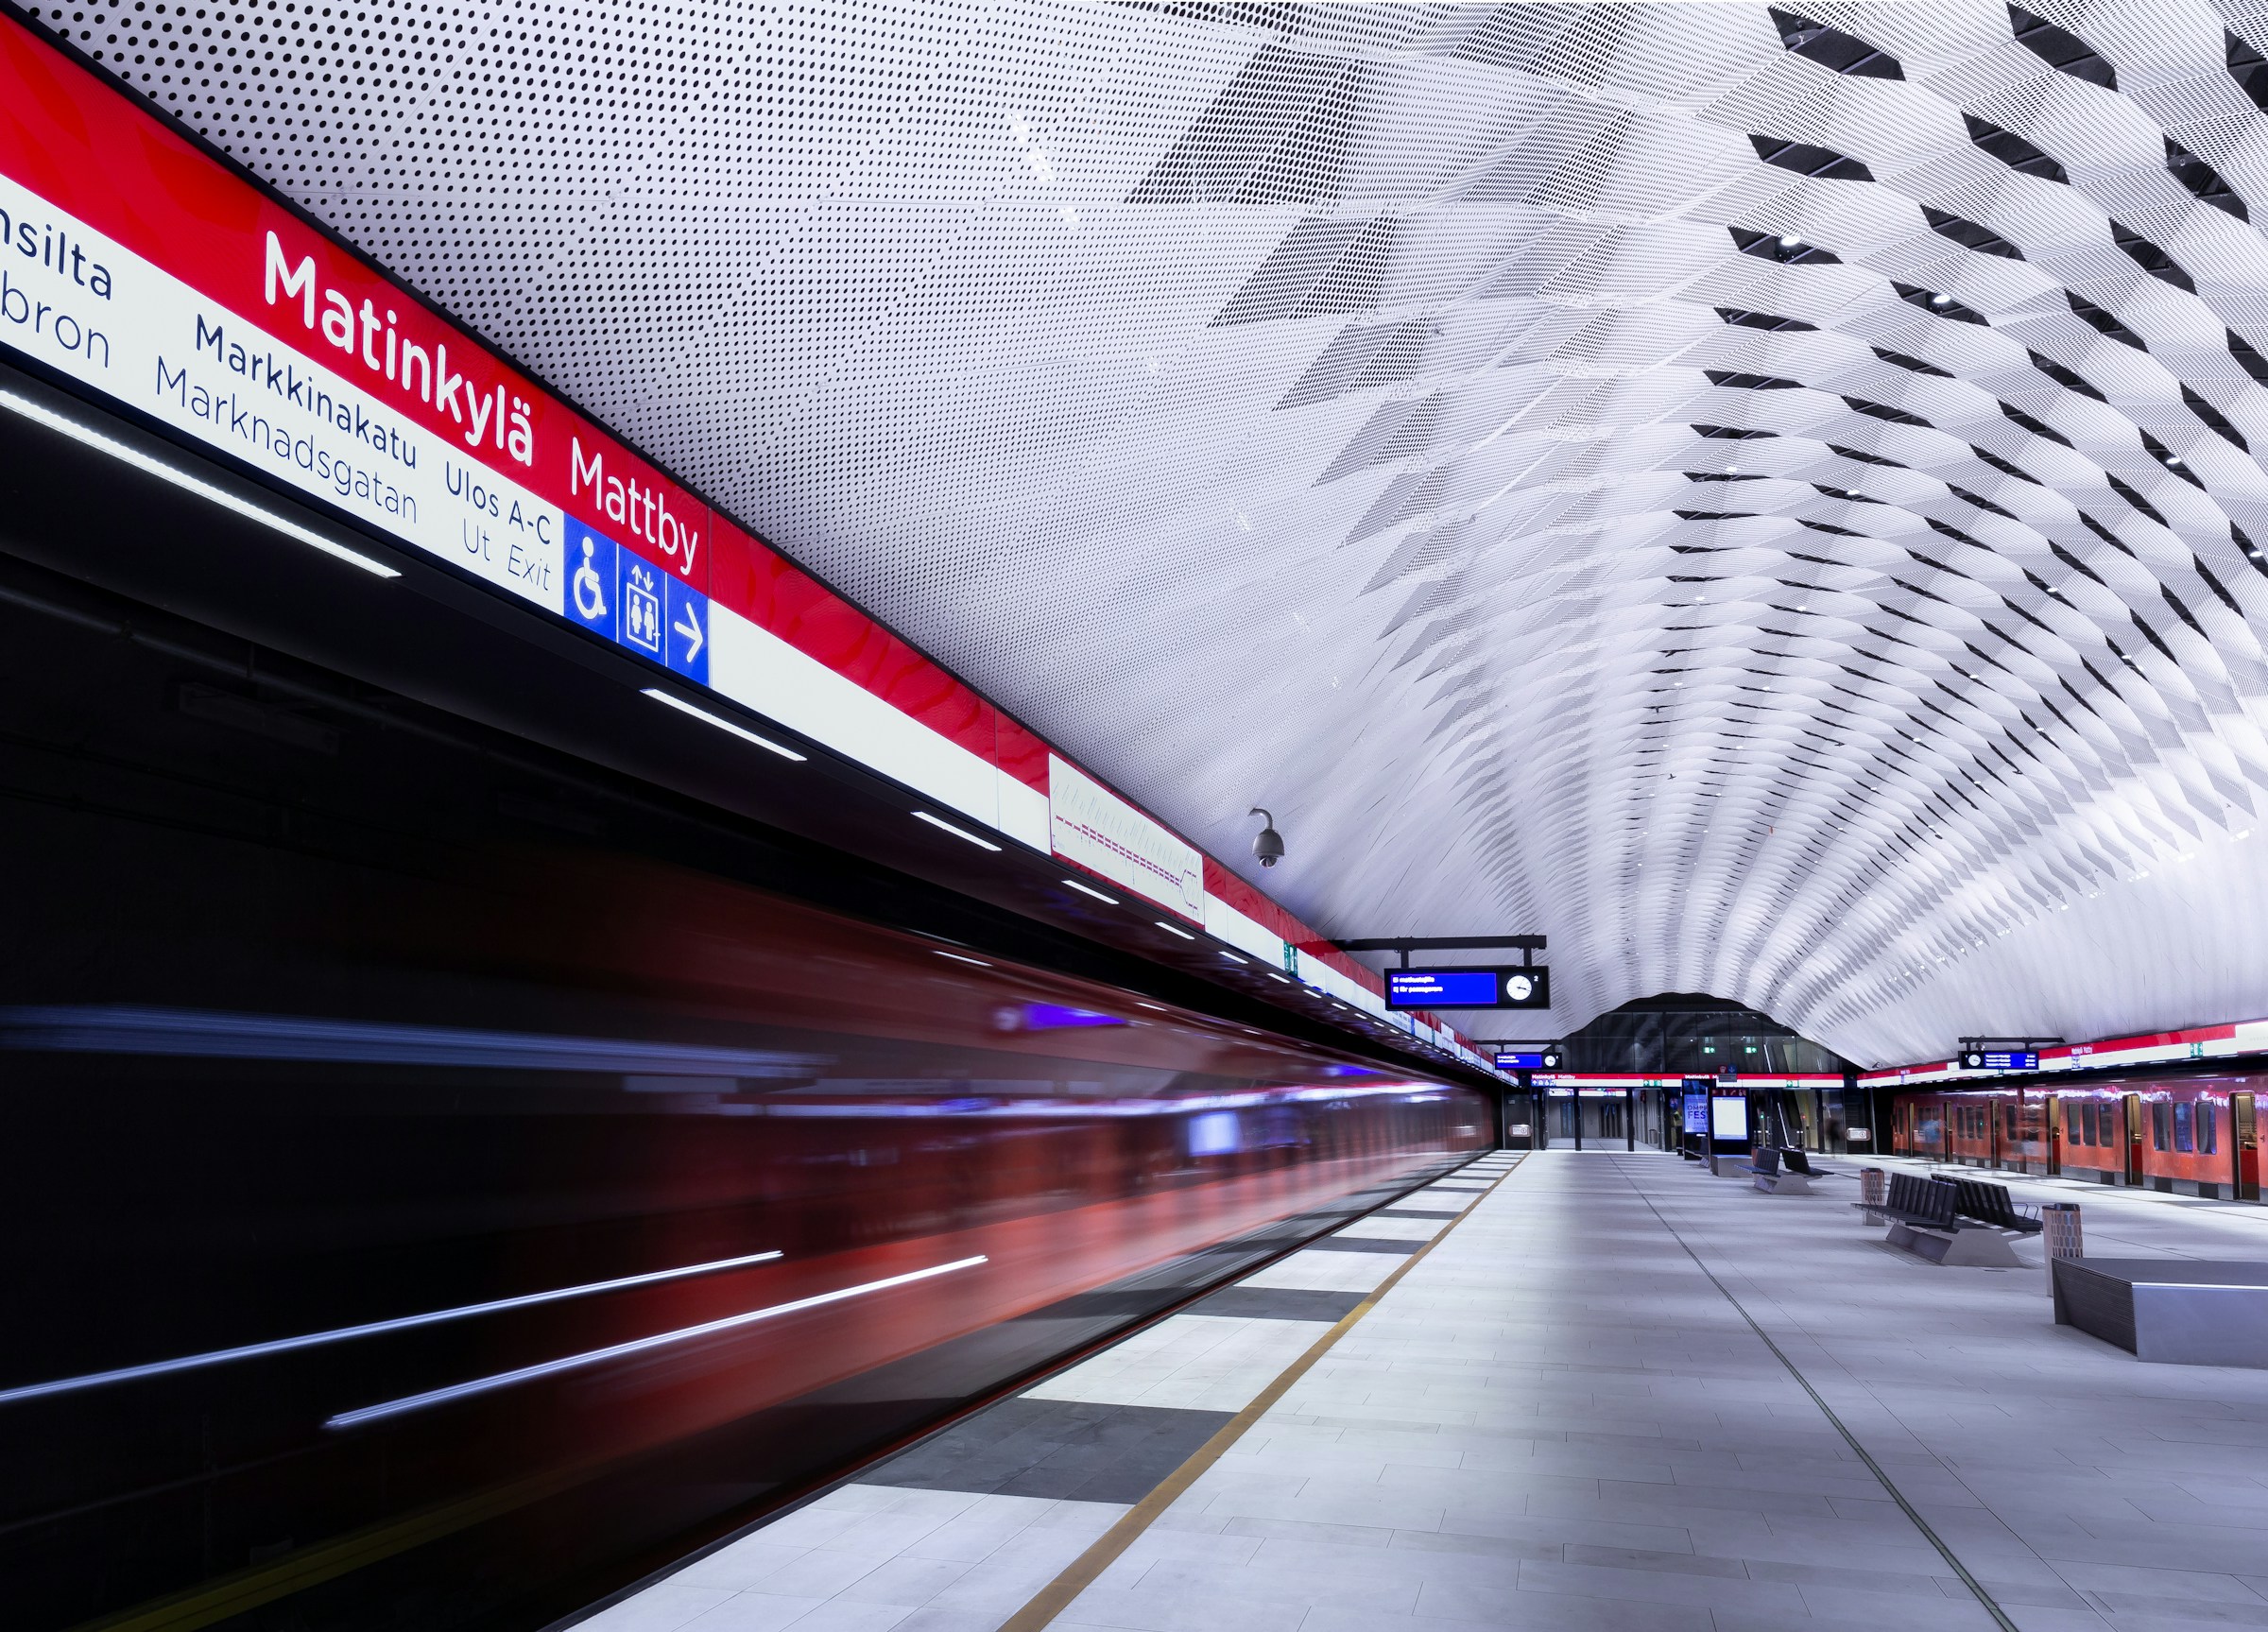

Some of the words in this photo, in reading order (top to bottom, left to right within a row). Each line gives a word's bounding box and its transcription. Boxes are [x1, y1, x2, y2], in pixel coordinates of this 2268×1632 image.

[1, 269, 109, 369] bron
[156, 355, 417, 524] Marknadsgatan
[196, 313, 417, 471] Markkinakatu
[265, 230, 533, 469] Matinkylä
[571, 436, 699, 577] Mattby
[446, 460, 499, 518] Ulos
[508, 500, 551, 545] A-C
[463, 518, 490, 561] Ut
[507, 544, 551, 592] Exit
